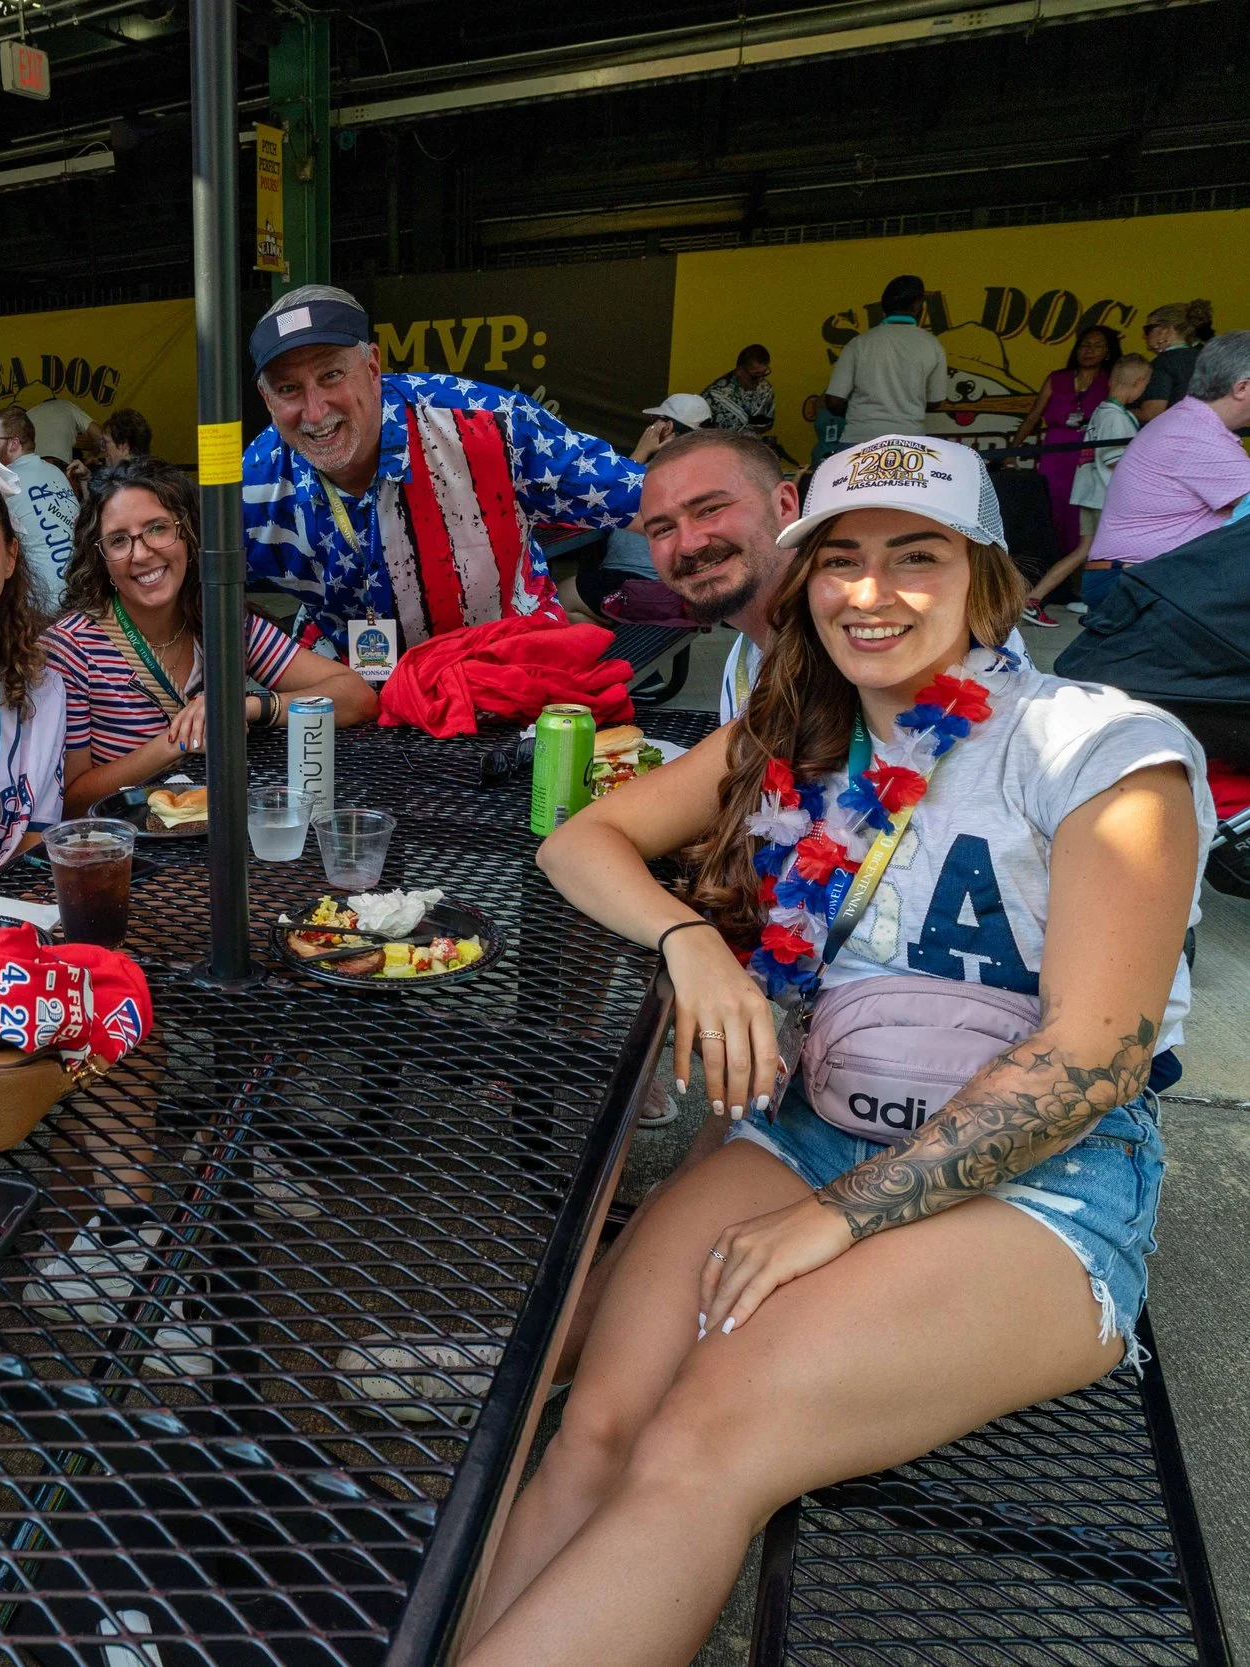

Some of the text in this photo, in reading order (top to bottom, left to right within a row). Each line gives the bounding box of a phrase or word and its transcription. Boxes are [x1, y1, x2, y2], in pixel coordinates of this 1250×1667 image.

[373, 314, 547, 373] MVP:
[40, 354, 121, 407] DOG
[863, 439, 924, 453] BICENTENNIAL
[860, 449, 924, 474] 200
[846, 480, 929, 492] MASSACHUSETTS
[930, 470, 953, 482] 2026
[126, 629, 141, 648] 200
[361, 633, 385, 645] 200
[843, 851, 884, 917] BICENTENNIAL
[828, 881, 845, 921] LOWELL
[848, 1092, 937, 1131] adi
